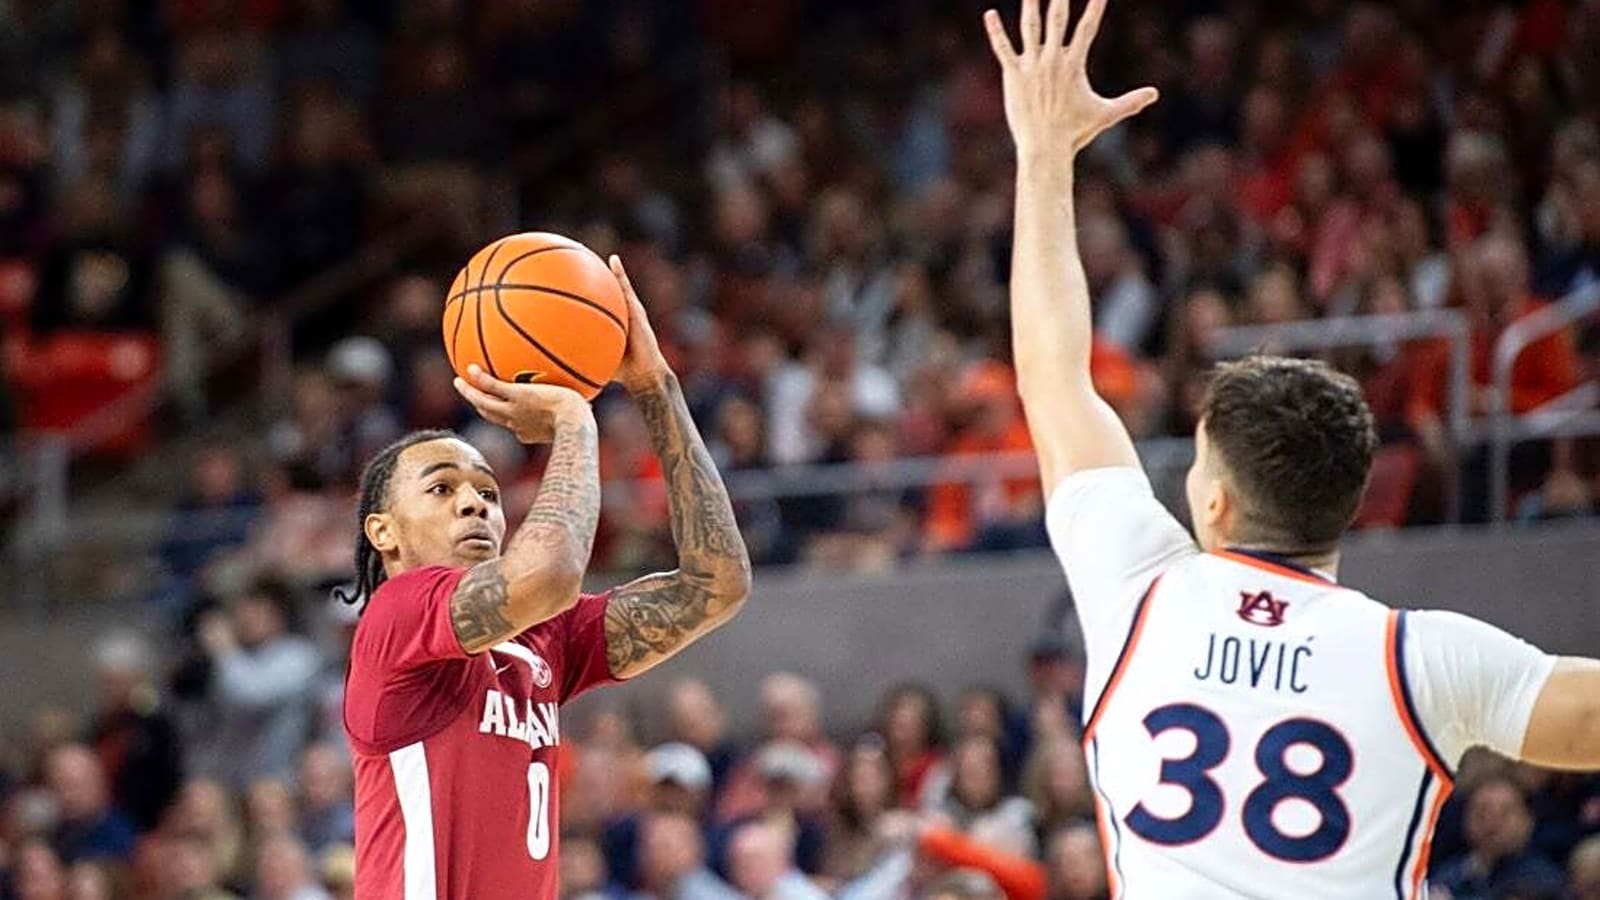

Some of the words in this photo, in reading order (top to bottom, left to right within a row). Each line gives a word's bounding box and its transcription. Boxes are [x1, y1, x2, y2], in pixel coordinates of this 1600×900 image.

[1194, 633, 1315, 693] JOVIĆ
[526, 761, 550, 861] 0
[1124, 702, 1355, 865] 38
